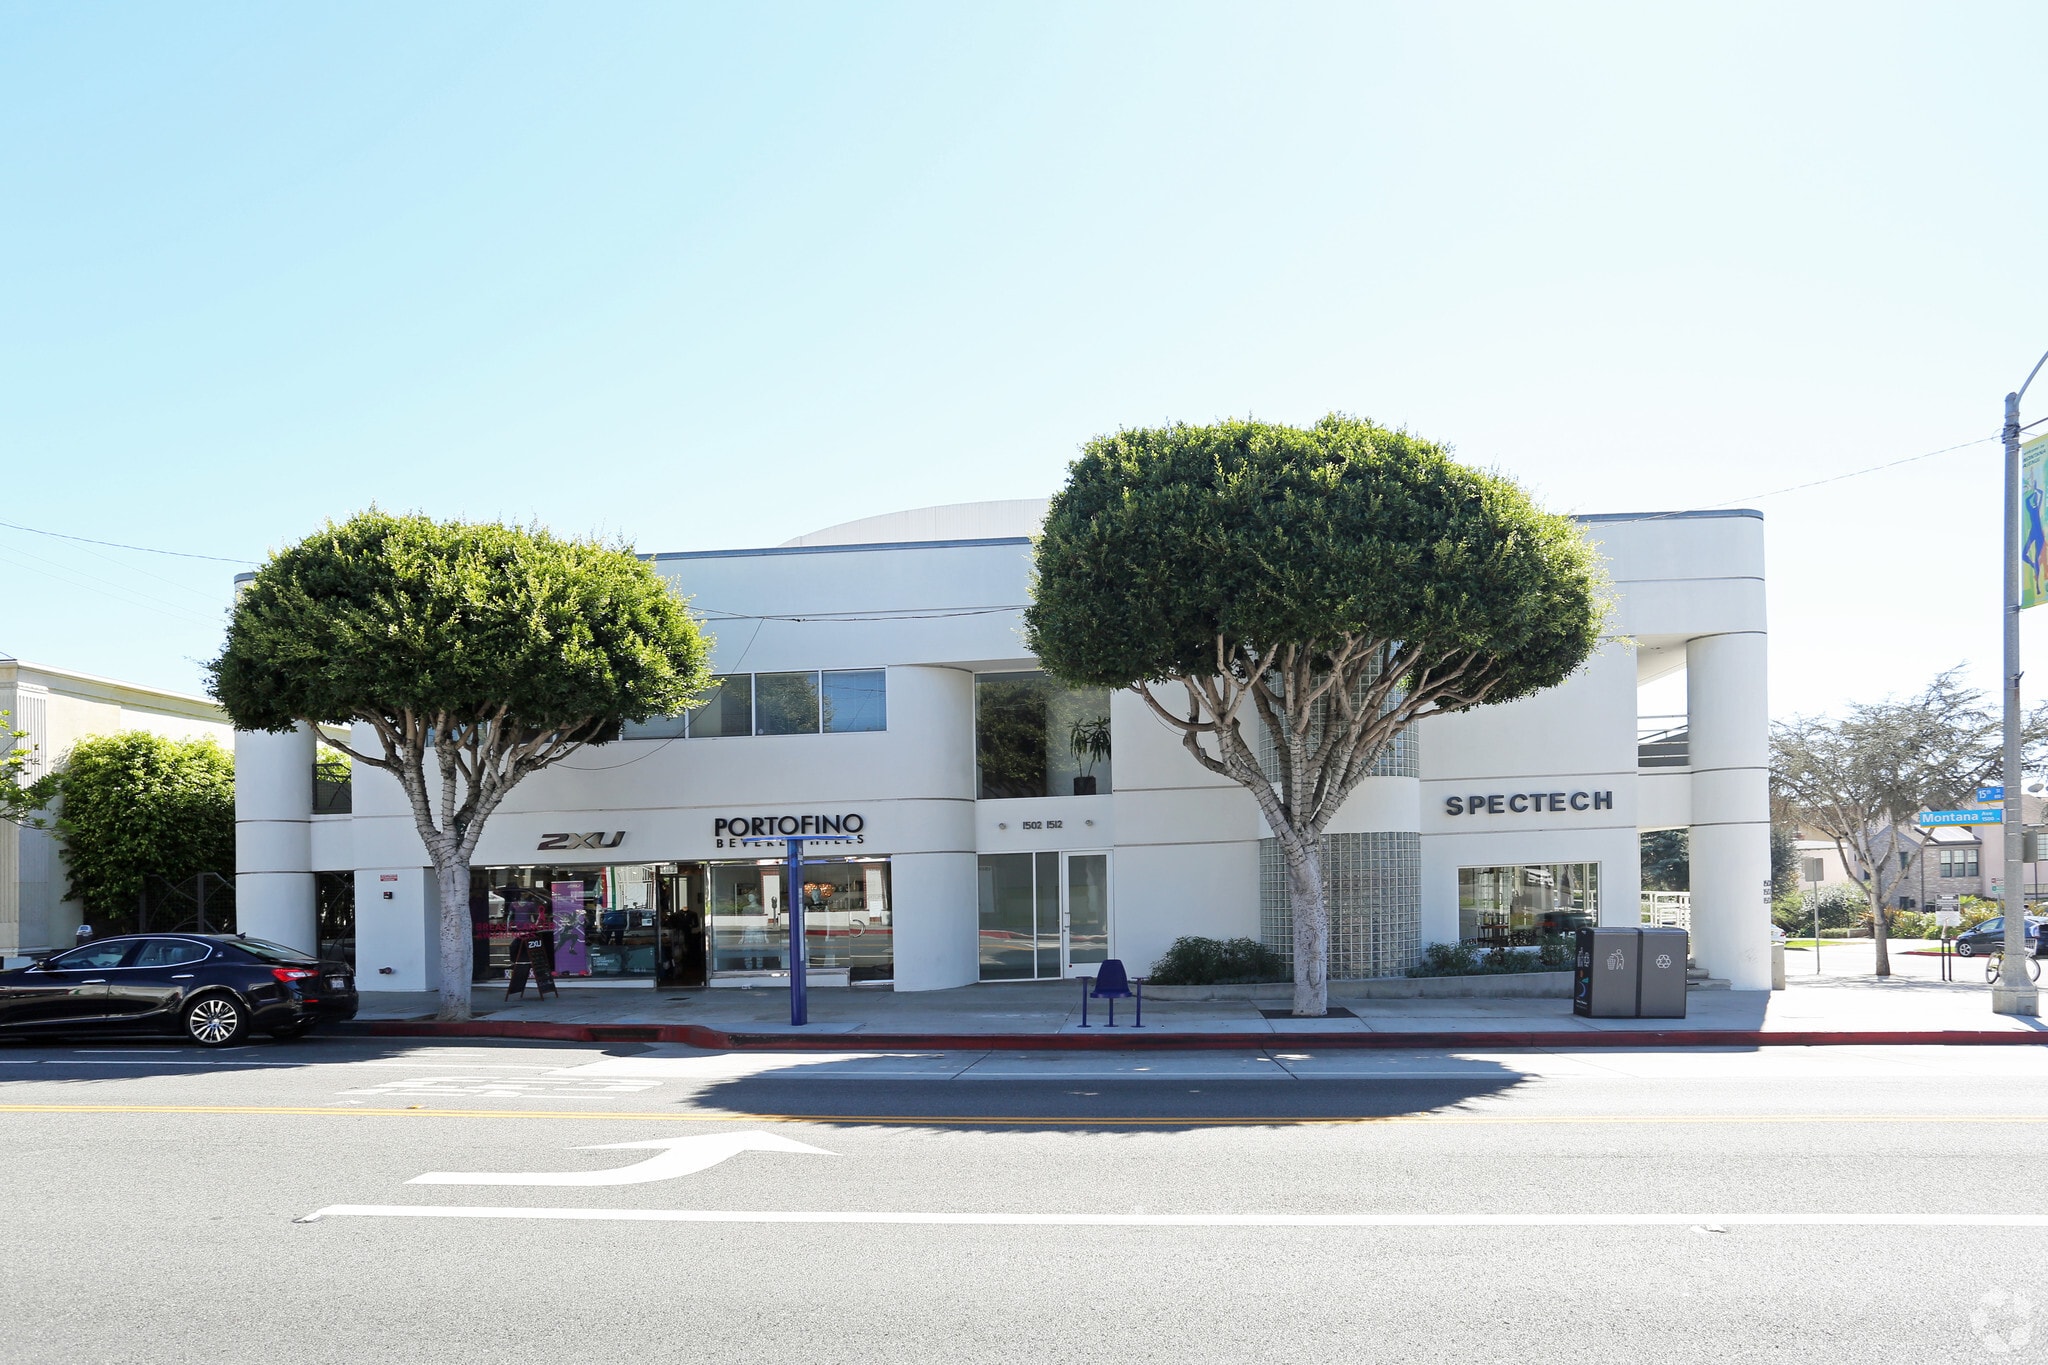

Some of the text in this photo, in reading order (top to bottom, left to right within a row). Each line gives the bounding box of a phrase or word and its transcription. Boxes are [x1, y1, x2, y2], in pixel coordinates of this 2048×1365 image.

[1446, 791, 1613, 816] SPECTECH
[1922, 813, 1978, 822] Montana
[714, 813, 864, 837] PORTOFINO
[1022, 820, 1063, 830] 1502 1512
[537, 831, 626, 850] 2XU
[528, 940, 542, 949] 2XU
